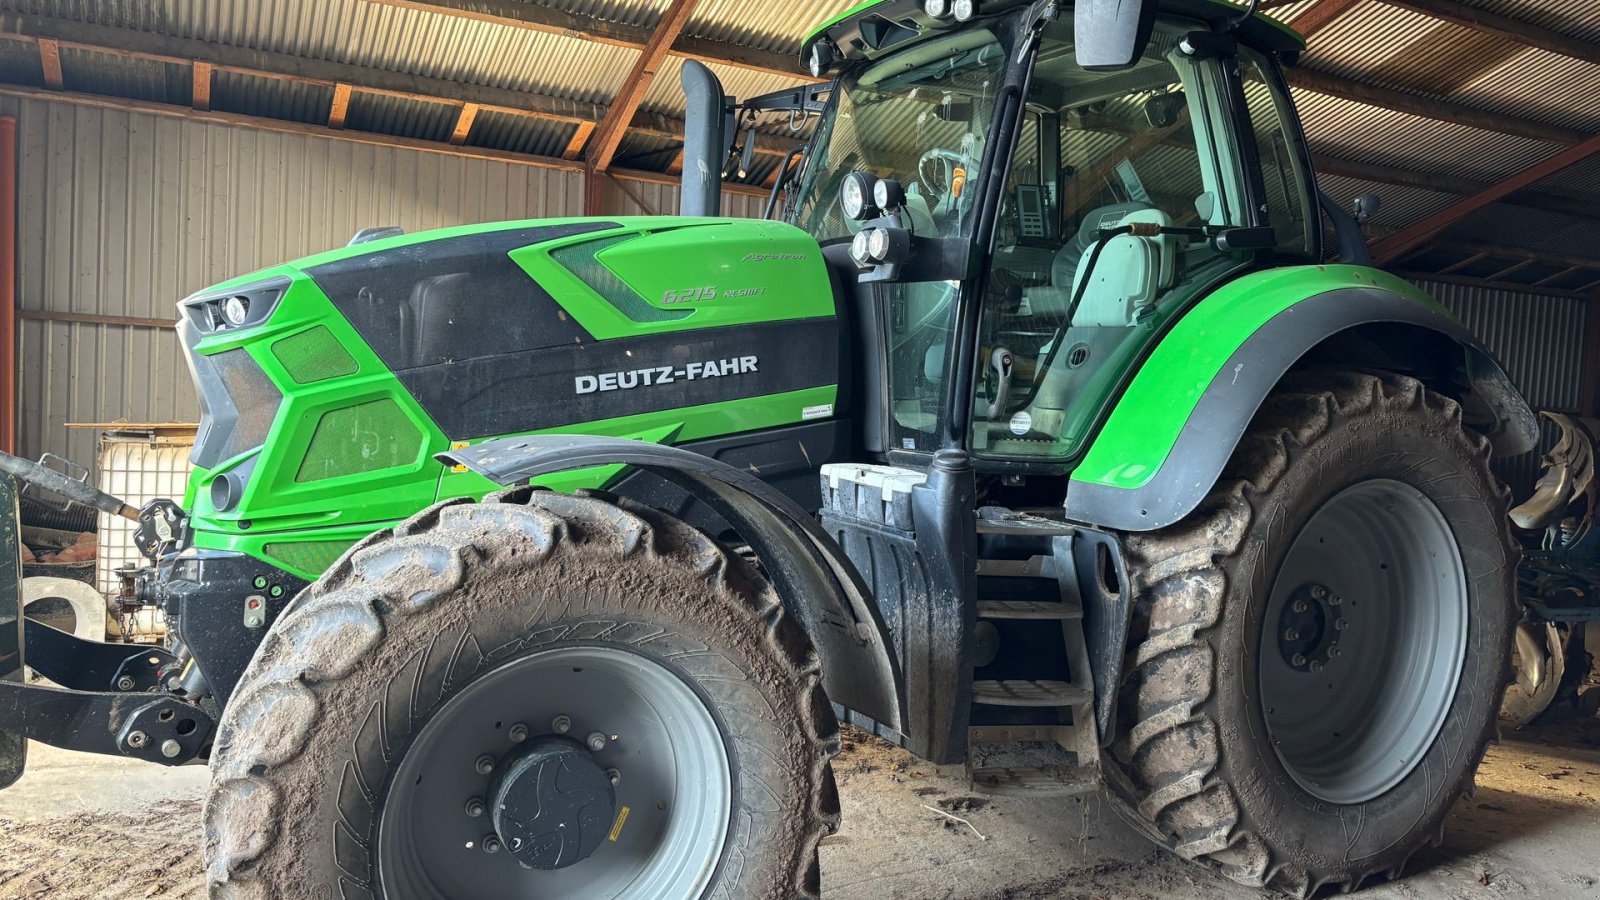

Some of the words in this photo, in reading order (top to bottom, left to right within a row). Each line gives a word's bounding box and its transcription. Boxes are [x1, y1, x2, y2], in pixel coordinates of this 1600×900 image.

[742, 252, 807, 263] Agrotron
[661, 287, 717, 305] 6215
[575, 356, 760, 396] DEUTZ-FAHR
